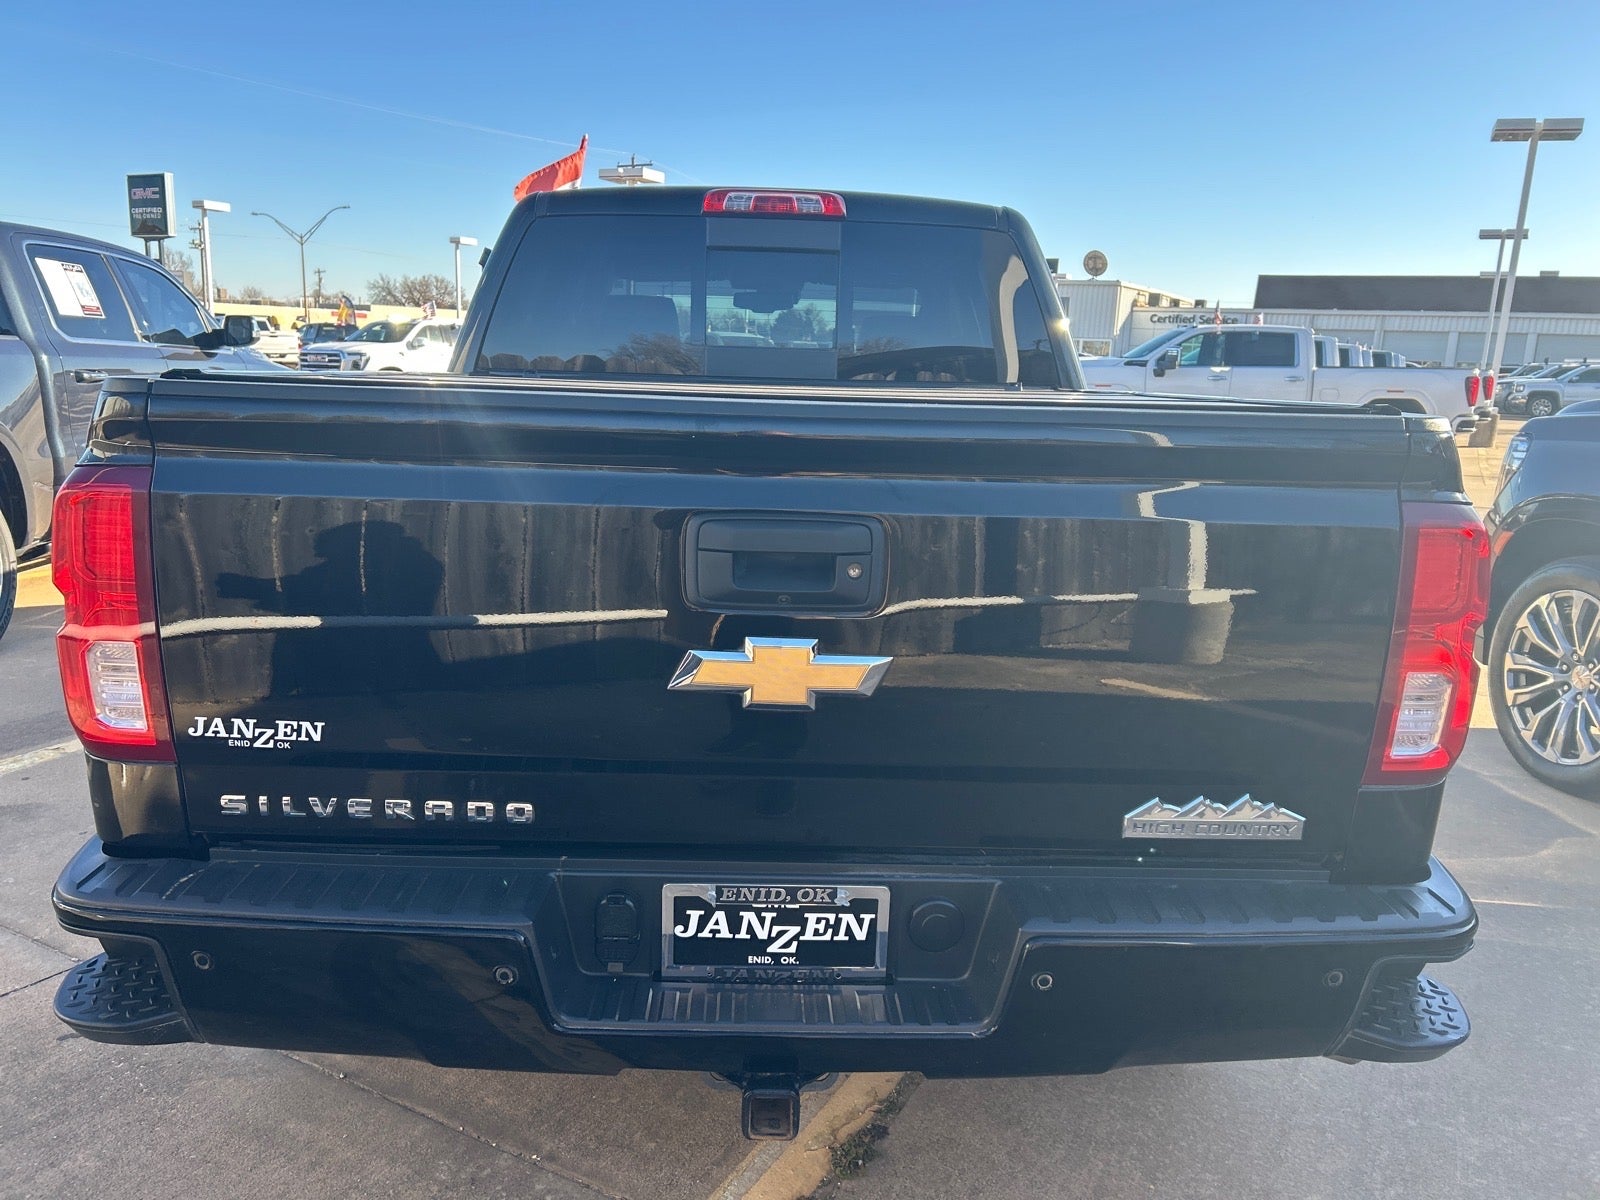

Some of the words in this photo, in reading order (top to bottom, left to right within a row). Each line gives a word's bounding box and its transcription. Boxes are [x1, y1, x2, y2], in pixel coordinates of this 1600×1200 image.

[131, 187, 160, 199] GMC
[1150, 314, 1195, 324] Certified
[1199, 315, 1238, 324] Serice
[188, 716, 325, 749] JANZEN
[228, 739, 251, 747] ENID
[277, 741, 291, 749] OK
[220, 794, 535, 824] SILVERADO
[1132, 823, 1185, 834] HIGH
[1194, 823, 1298, 836] COUNTRY
[720, 887, 791, 902] ENID,
[796, 888, 834, 903] OK
[674, 909, 876, 953] JANZEN
[748, 956, 775, 965] ENID,
[780, 956, 800, 965] OK.
